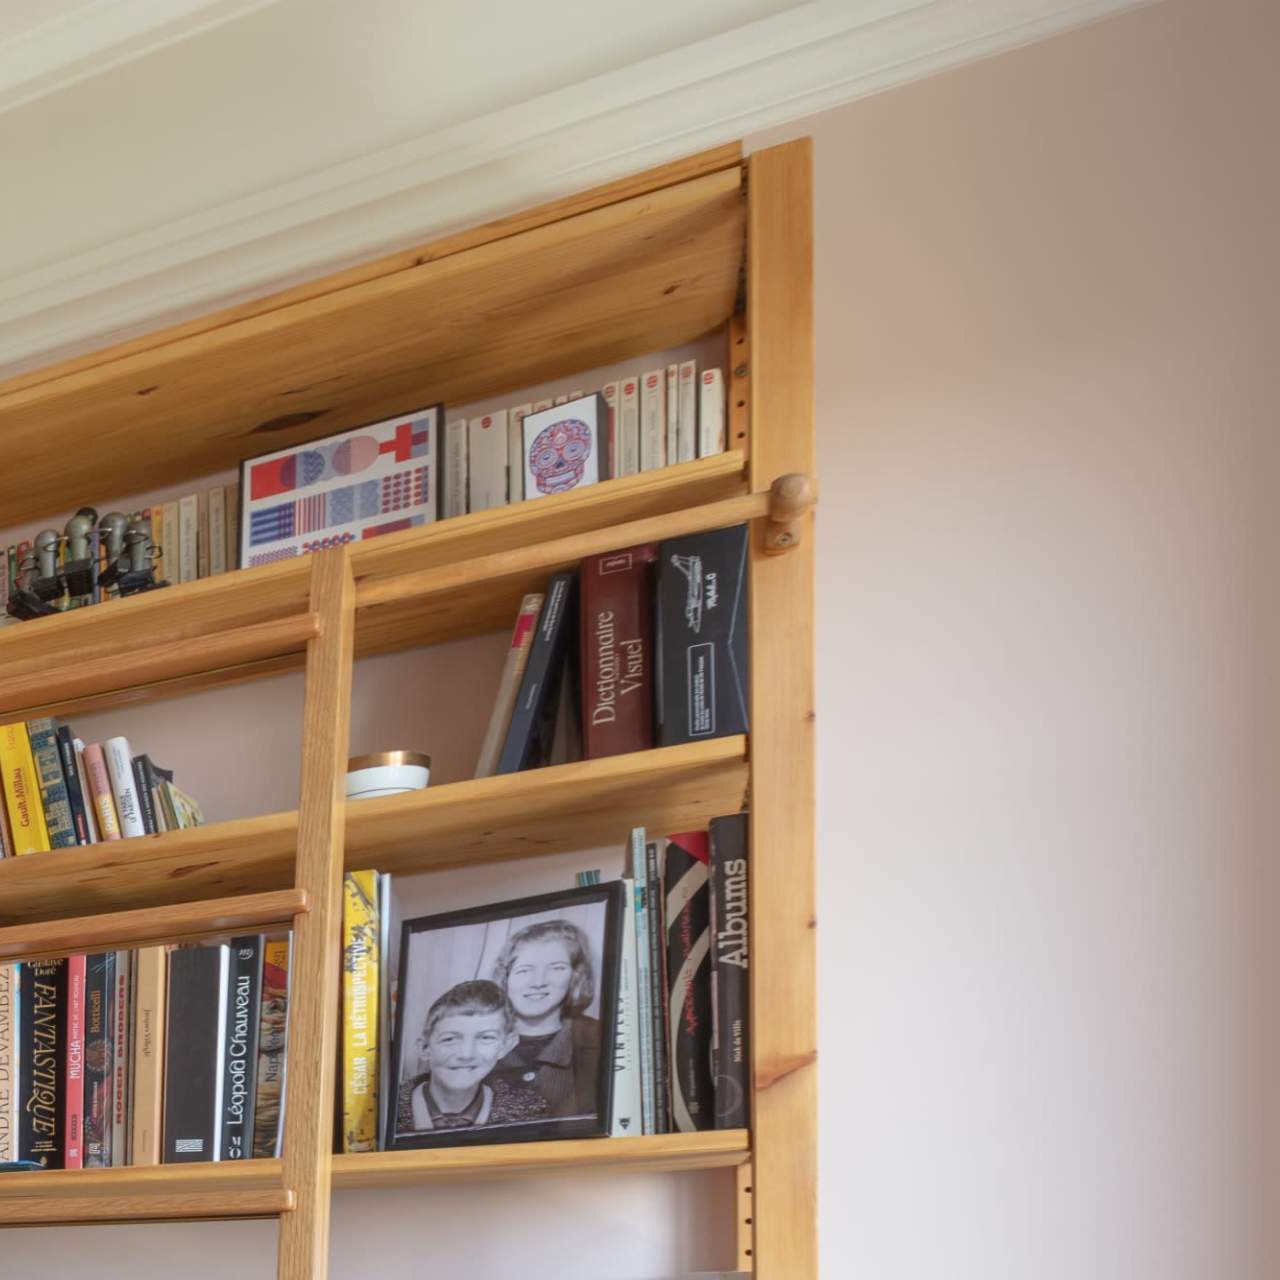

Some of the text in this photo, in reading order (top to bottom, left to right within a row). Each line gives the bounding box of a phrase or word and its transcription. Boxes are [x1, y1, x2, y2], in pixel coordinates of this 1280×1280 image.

[593, 610, 616, 726] Dictionnaire
[621, 639, 642, 695] Visuel
[12, 767, 31, 828] Gault Millau
[720, 858, 747, 970] Albums
[32, 983, 57, 1135] FANTASTIQUE
[69, 1040, 81, 1079] MUCHA
[90, 990, 101, 1033] Botticelli
[226, 975, 252, 1125] Léopold Chauveau
[352, 931, 369, 1096] CÉSAR LA RÉTROSPECTIVE
